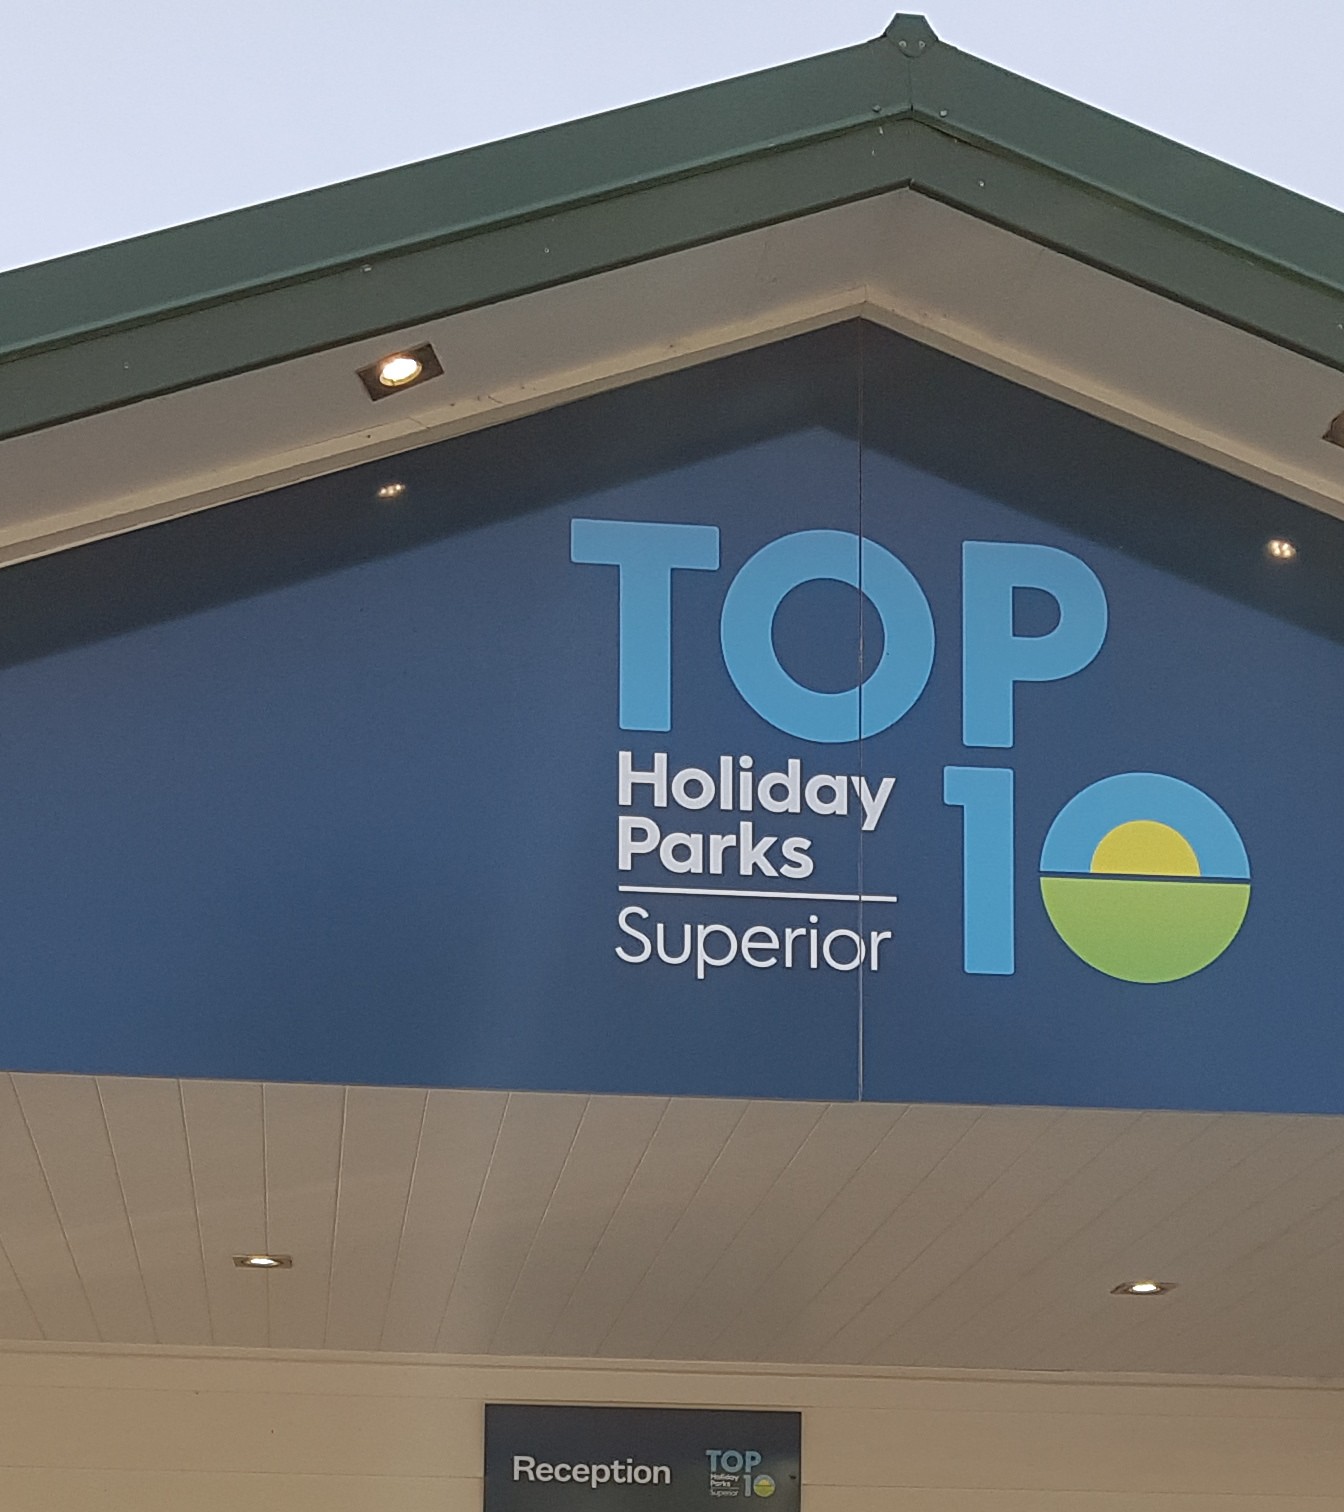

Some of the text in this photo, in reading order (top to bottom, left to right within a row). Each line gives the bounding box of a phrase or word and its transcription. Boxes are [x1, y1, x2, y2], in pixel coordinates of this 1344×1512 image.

[570, 518, 1109, 748] TOP
[617, 750, 897, 832] Holiday
[617, 815, 815, 879] Parks
[943, 766, 1251, 984] 10
[615, 905, 892, 979] Superior
[513, 1455, 671, 1489] Reception
[705, 1449, 762, 1473] TOP
[743, 1474, 776, 1497] 10
